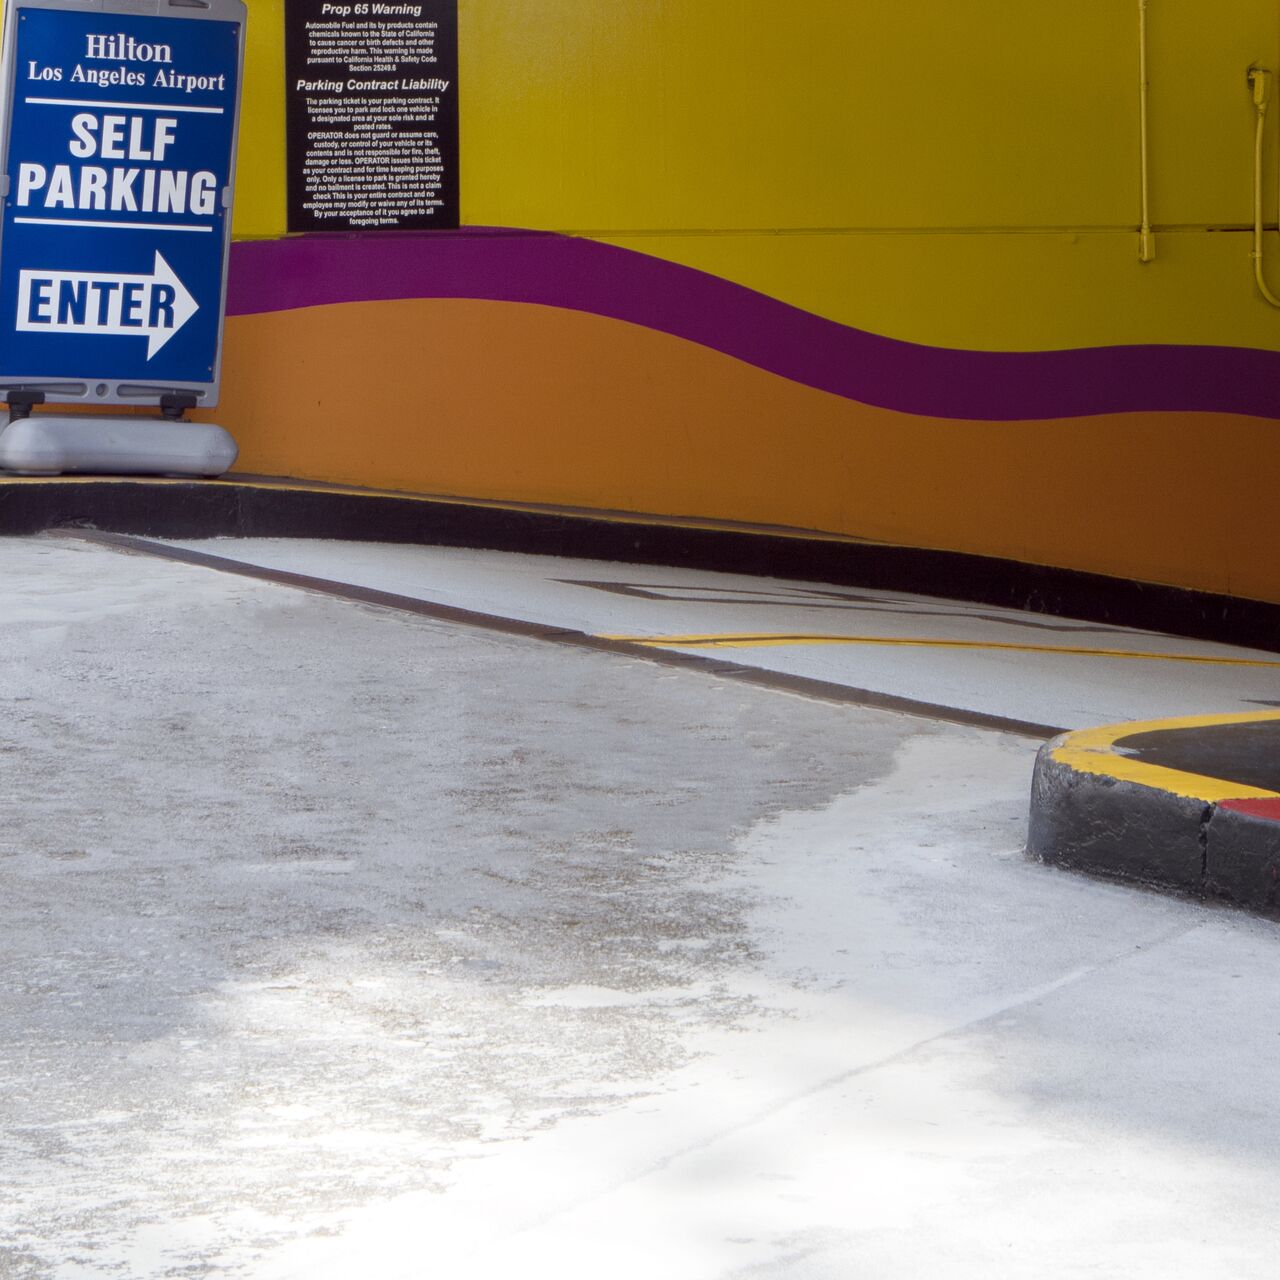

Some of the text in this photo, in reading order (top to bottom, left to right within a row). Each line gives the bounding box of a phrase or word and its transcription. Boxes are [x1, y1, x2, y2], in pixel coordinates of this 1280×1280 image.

[322, 3, 421, 16] Prop 65 Warning
[85, 33, 172, 63] Hilton
[28, 61, 225, 93] Los Angeles Airport
[296, 79, 448, 93] Parking Contract Liability
[69, 113, 177, 161] SELF
[17, 163, 217, 215] PARKING
[28, 278, 176, 328] ENTER
